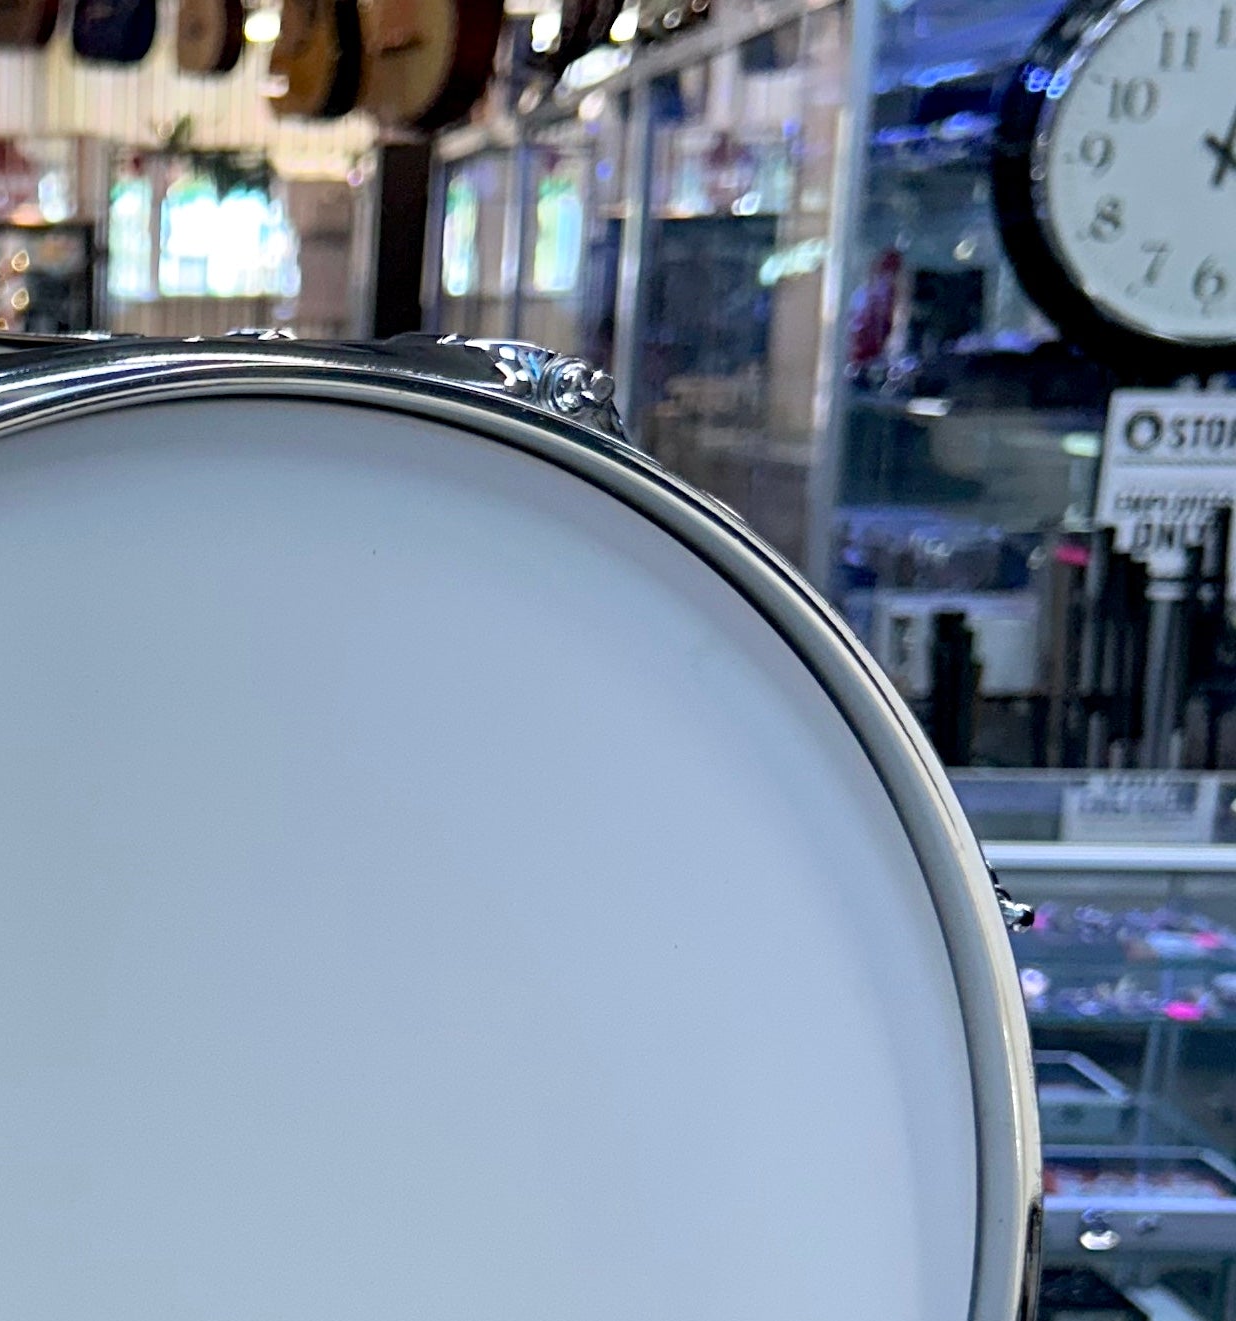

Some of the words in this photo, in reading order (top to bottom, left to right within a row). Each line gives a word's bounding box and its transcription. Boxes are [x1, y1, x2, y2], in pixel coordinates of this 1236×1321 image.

[1217, 4, 1235, 46] 1
[1160, 26, 1200, 71] 11
[1109, 78, 1160, 123] 10
[1079, 131, 1115, 175] 9
[1089, 196, 1124, 243] 8
[1140, 240, 1171, 286] 7
[1193, 252, 1229, 302] 6
